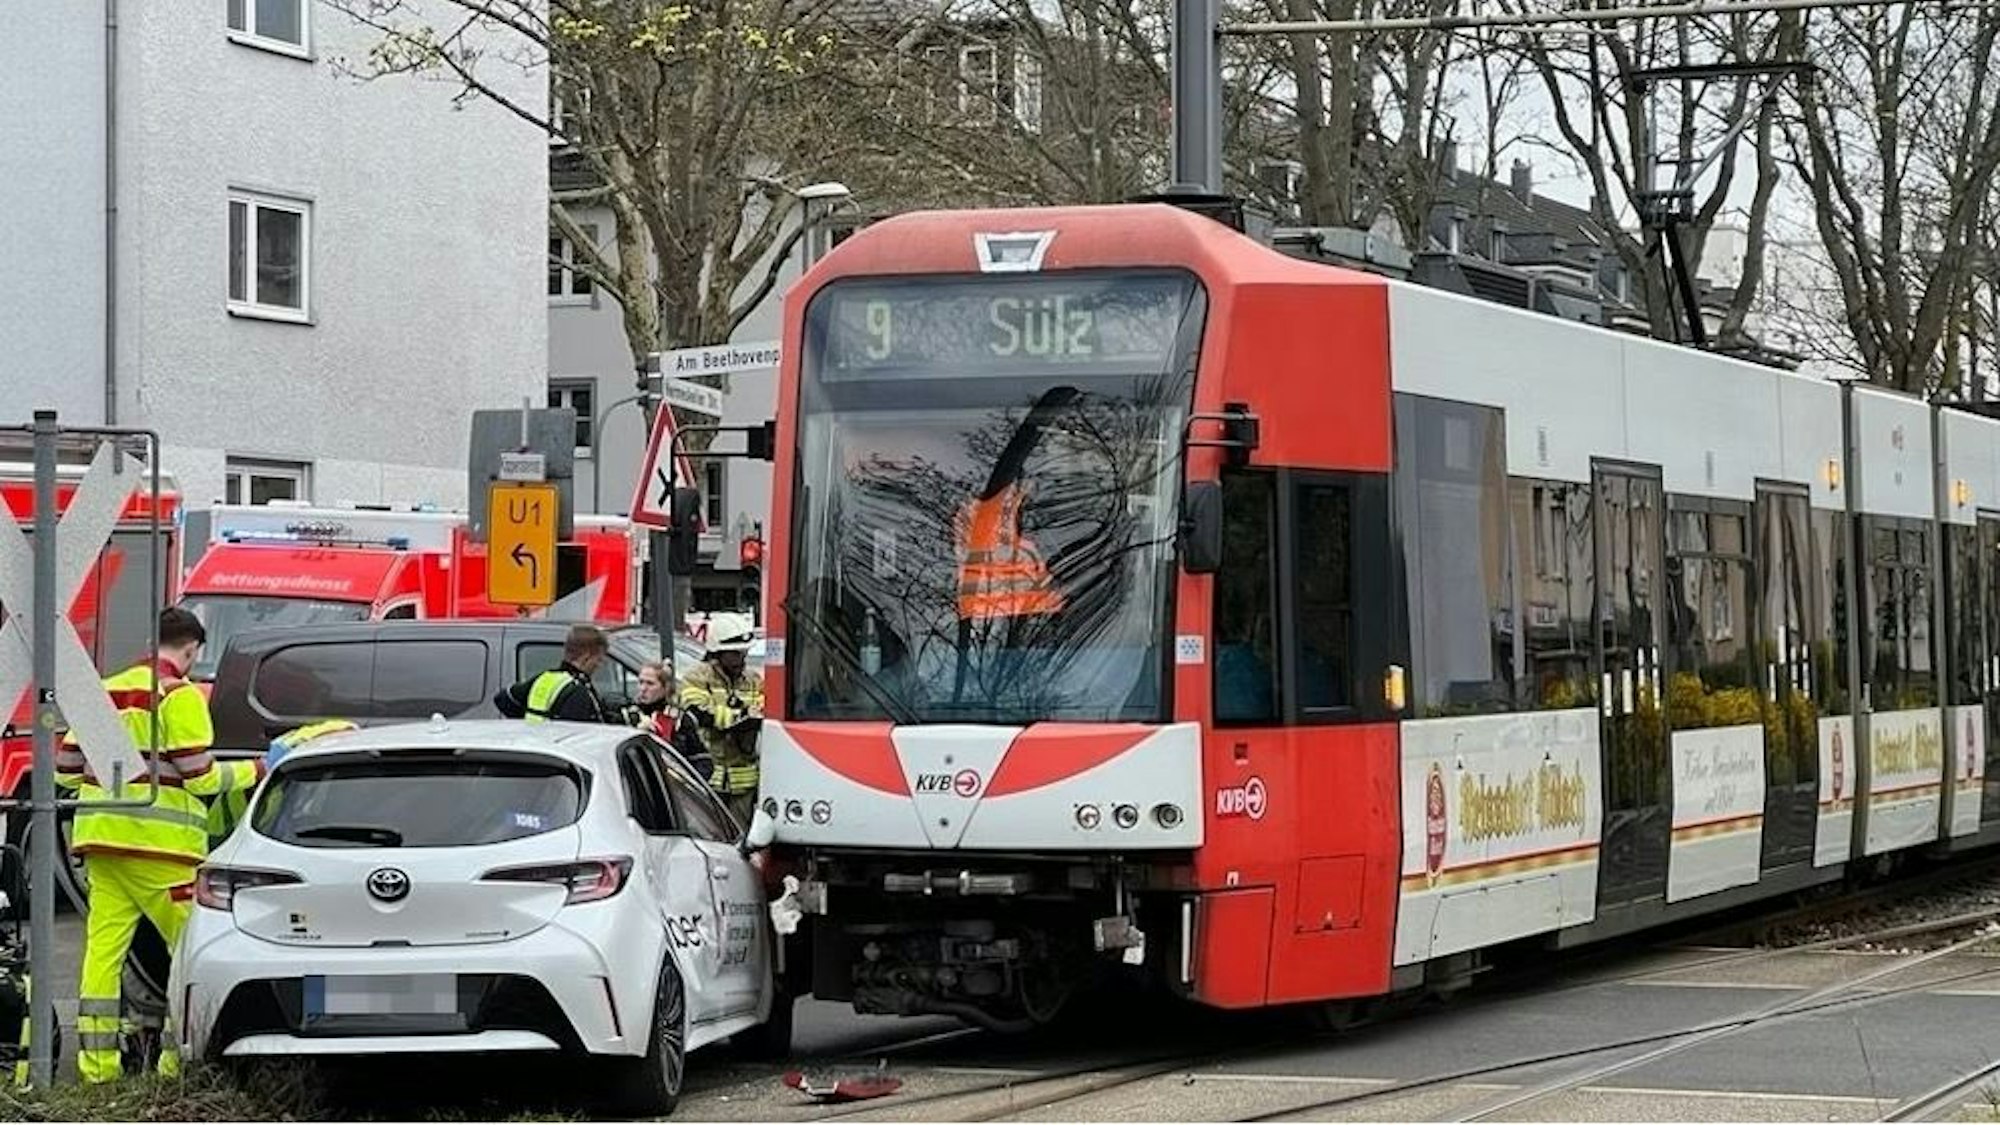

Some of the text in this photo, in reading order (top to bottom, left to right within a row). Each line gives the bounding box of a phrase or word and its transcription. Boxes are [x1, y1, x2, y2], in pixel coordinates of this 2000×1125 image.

[866, 295, 1093, 360] 9 Sülz
[676, 354, 697, 371] Am
[509, 499, 541, 527] U1
[209, 572, 353, 592] Rettungsdienst
[916, 774, 952, 791] KVB
[1216, 787, 1246, 815] KVB
